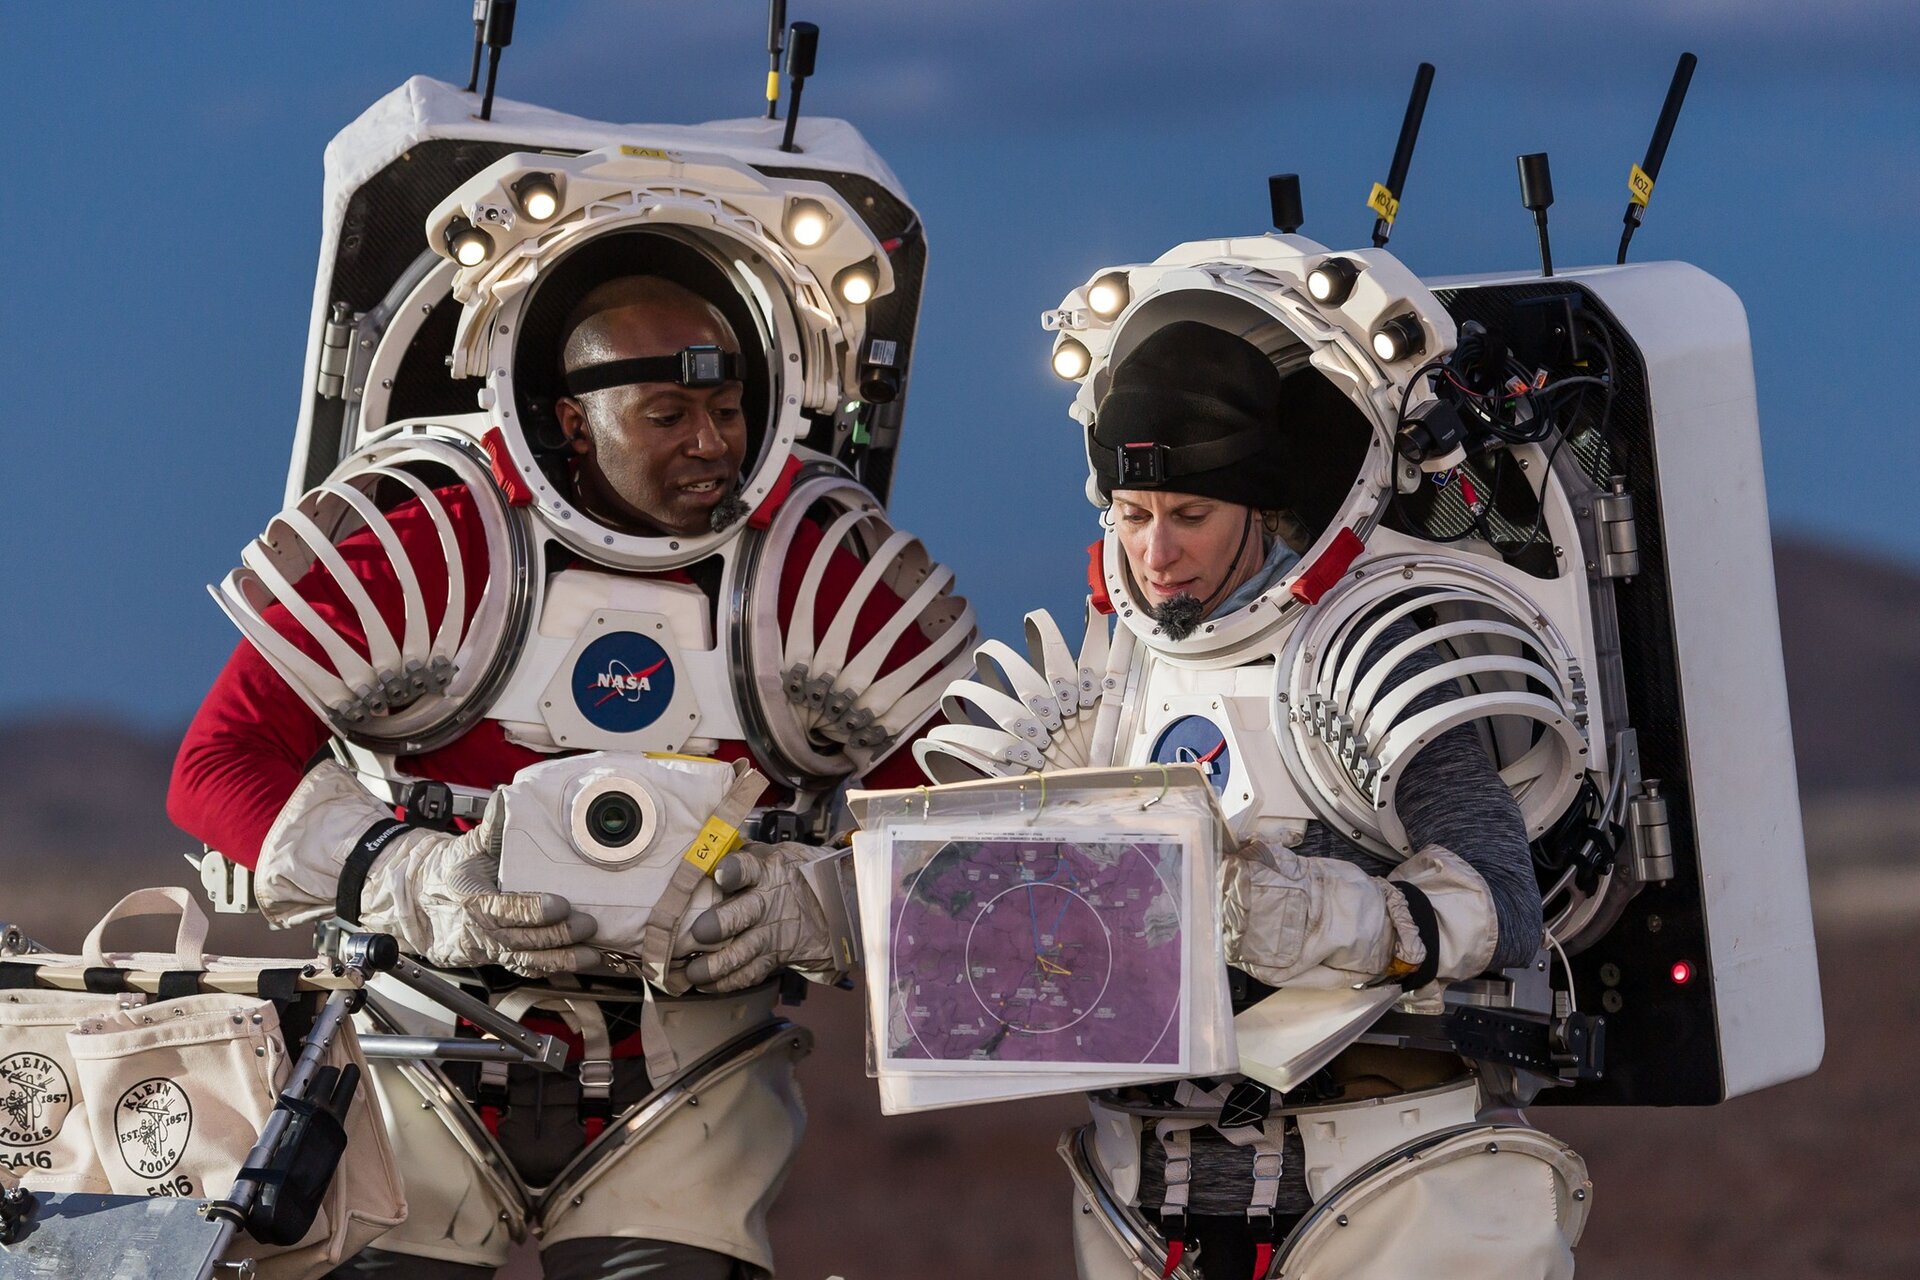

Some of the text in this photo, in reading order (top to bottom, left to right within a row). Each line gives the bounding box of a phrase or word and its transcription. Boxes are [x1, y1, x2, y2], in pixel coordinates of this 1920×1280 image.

[1633, 172, 1649, 196] KOZ
[1374, 190, 1391, 213] KOZ
[597, 673, 651, 691] NASA
[696, 843, 710, 860] EV
[0, 1057, 52, 1079] KLEIN
[41, 1093, 68, 1104] 1857
[123, 1082, 172, 1111] KLEIN
[0, 1126, 53, 1143] TOOLS
[120, 1111, 188, 1144] EST. 1857
[0, 1150, 52, 1171] 5416
[139, 1147, 177, 1174] TOOLS
[146, 1174, 194, 1198] 5416
